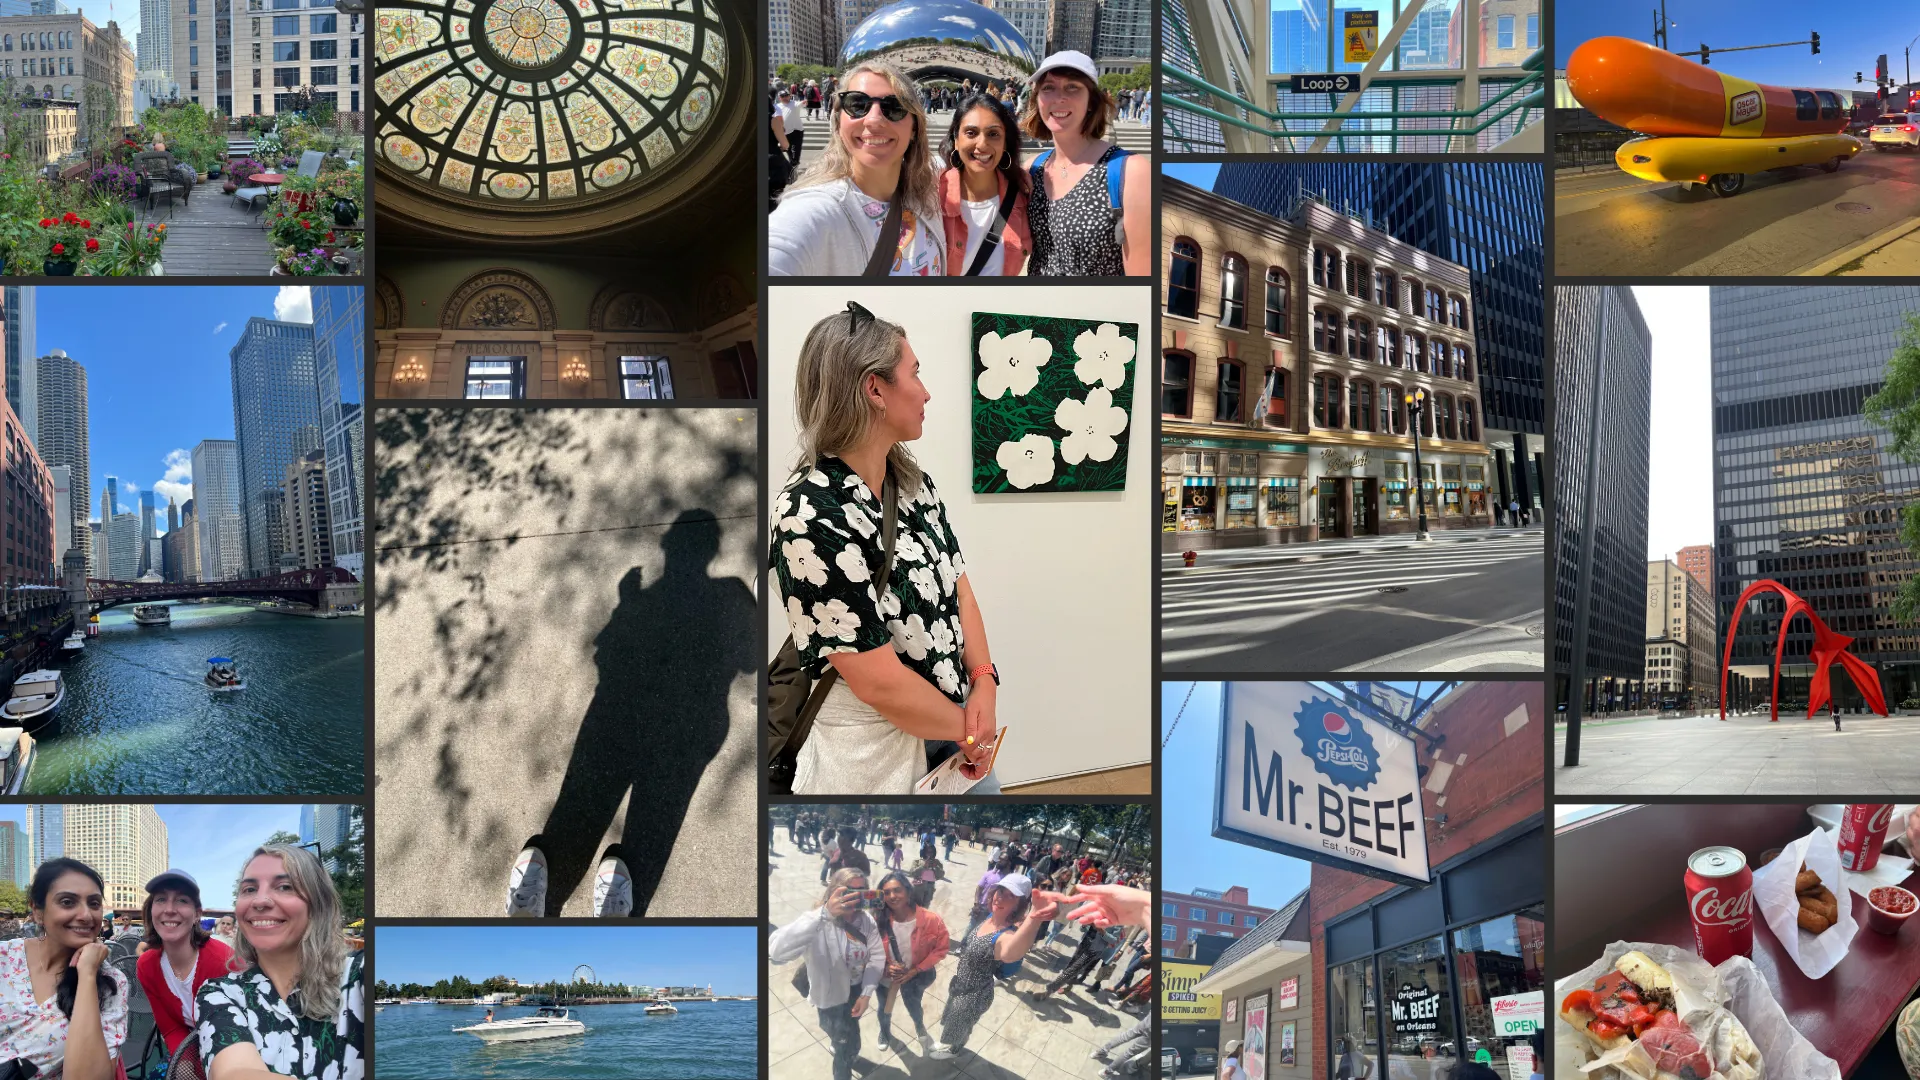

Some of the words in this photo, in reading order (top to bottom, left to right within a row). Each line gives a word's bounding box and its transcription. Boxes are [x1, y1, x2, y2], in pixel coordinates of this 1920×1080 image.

[1301, 78, 1333, 91] Loop
[1736, 98, 1756, 109] Oscar
[1736, 104, 1757, 117] Mayer
[465, 343, 529, 354] MEMORIAL
[1322, 838, 1341, 851] Est.
[1344, 845, 1367, 859] 1979
[1857, 845, 1870, 870] RECYCLE
[1171, 993, 1195, 1001] SPIKED
[1397, 988, 1428, 1000] Original
[1168, 1006, 1190, 1014] GETTING
[1191, 1006, 1208, 1014] JUICY
[1391, 1000, 1408, 1021] Mr.
[1410, 993, 1440, 1020] BEEF
[1406, 1021, 1437, 1031] Orleans
[1504, 1019, 1539, 1033] OPEN
